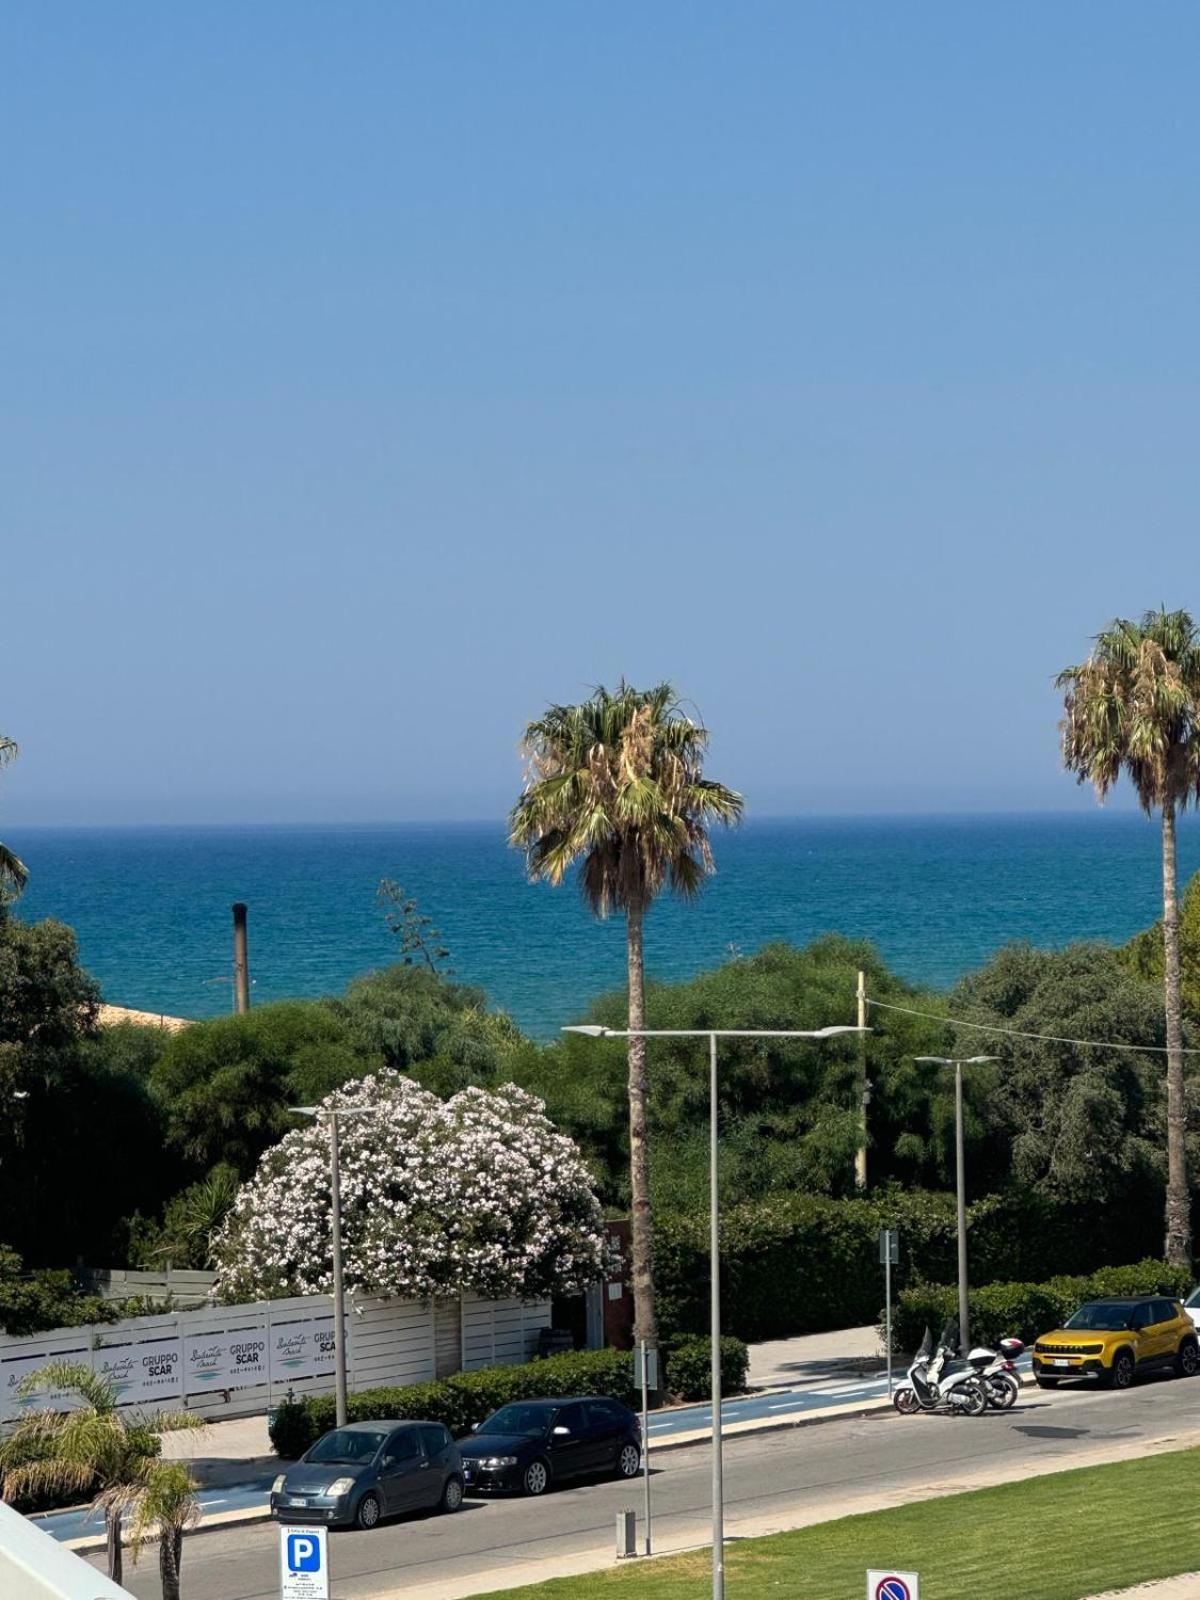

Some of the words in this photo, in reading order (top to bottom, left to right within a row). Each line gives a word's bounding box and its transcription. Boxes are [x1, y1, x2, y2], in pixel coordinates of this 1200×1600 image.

[314, 1329, 348, 1343] GRUPO
[229, 1341, 265, 1355] GRUPPO
[319, 1342, 336, 1352] SCA
[142, 1353, 178, 1367] GRUPPO
[236, 1353, 259, 1364] SCAR
[148, 1364, 172, 1376] SCAR
[293, 1538, 314, 1568] P
